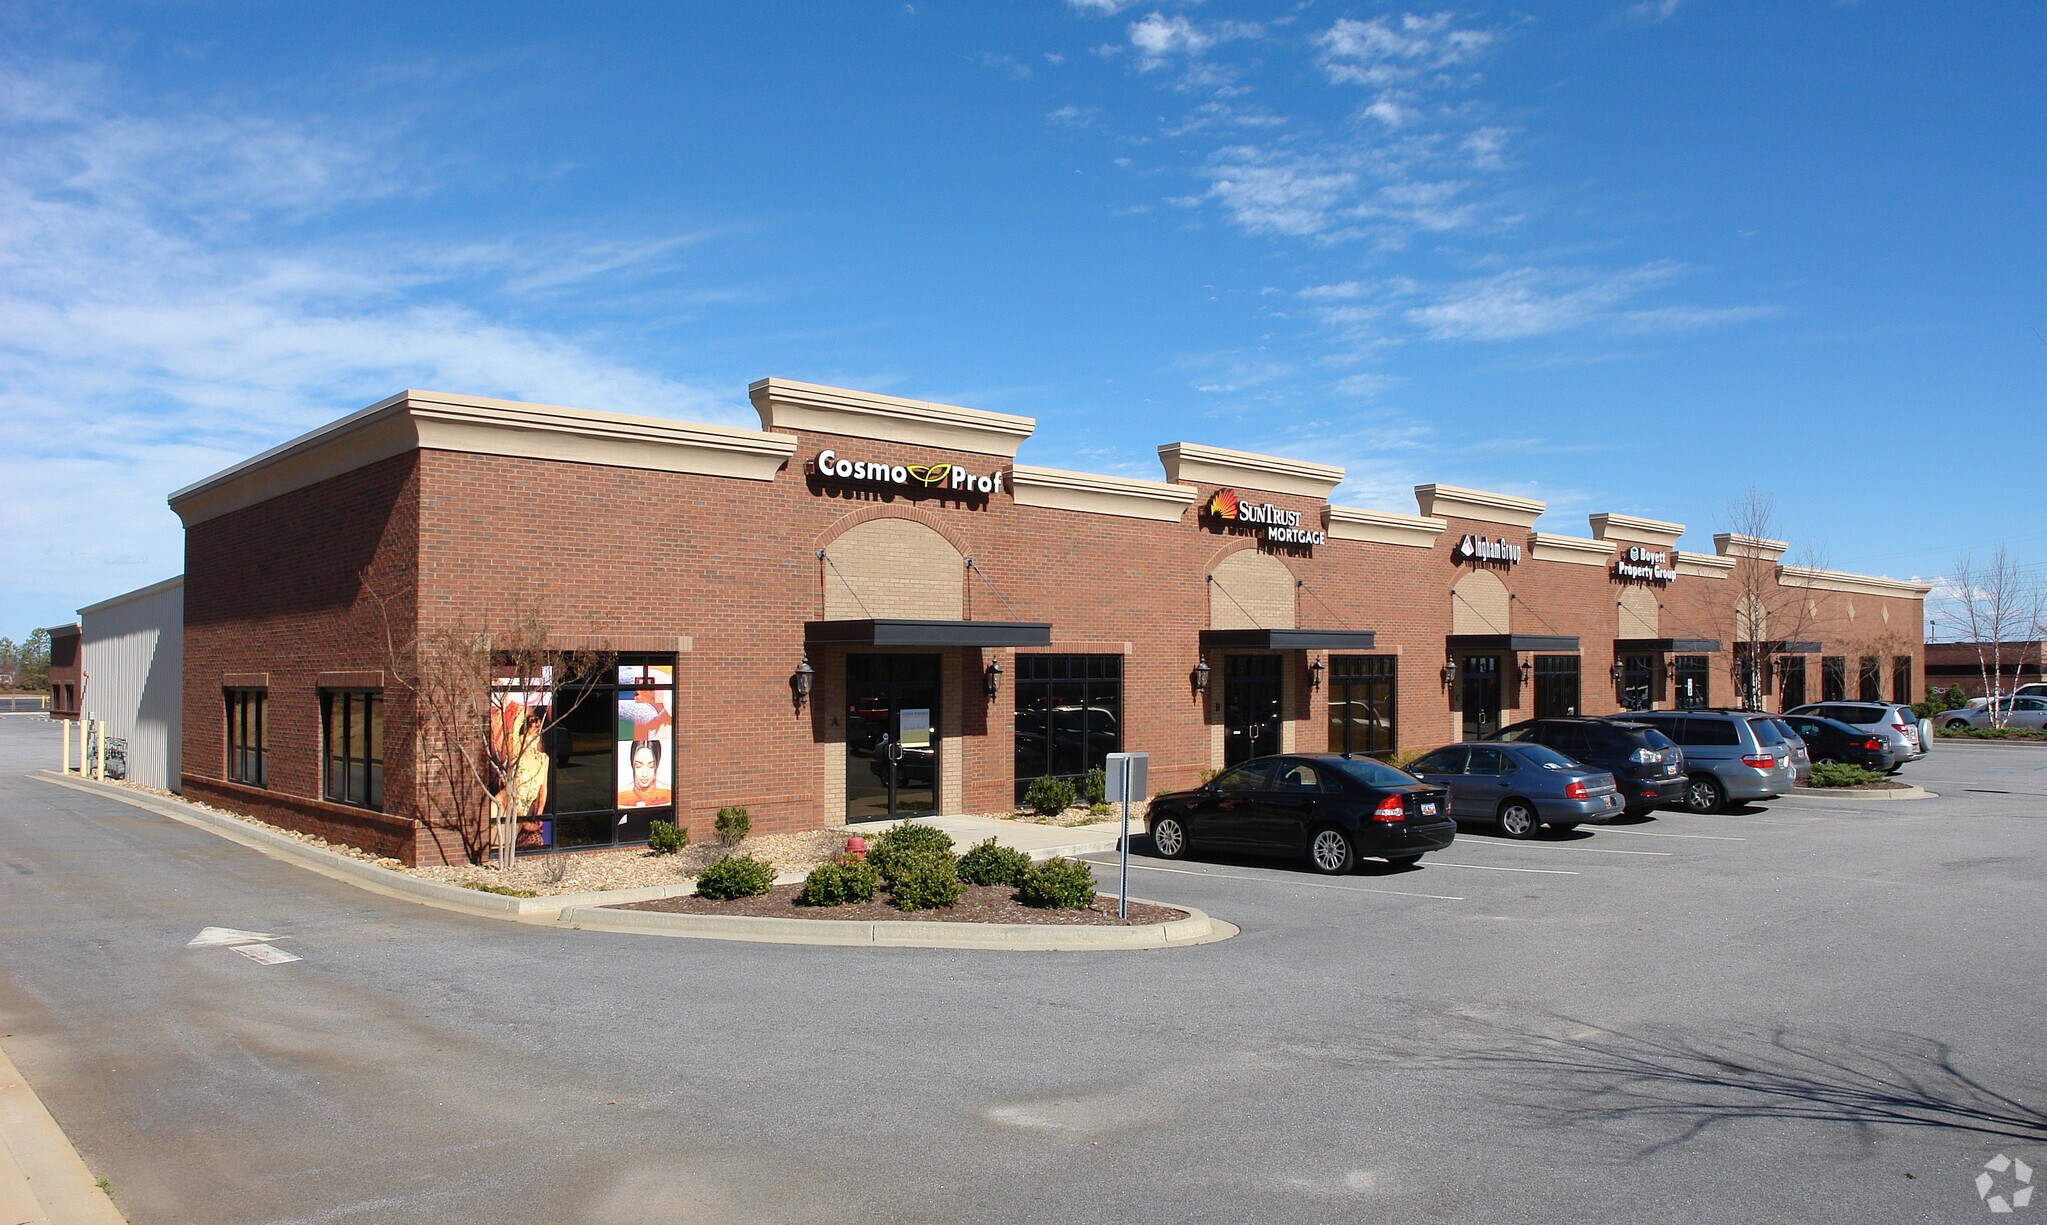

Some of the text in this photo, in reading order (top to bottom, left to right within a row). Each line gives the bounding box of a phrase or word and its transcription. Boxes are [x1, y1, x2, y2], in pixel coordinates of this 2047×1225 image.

[817, 449, 1002, 494] Cosmo Prof
[1268, 526, 1325, 545] MORTGAGE
[1475, 534, 1521, 565] Ingham Group
[1640, 547, 1666, 564] Boyett
[1618, 561, 1677, 582] Property Group
